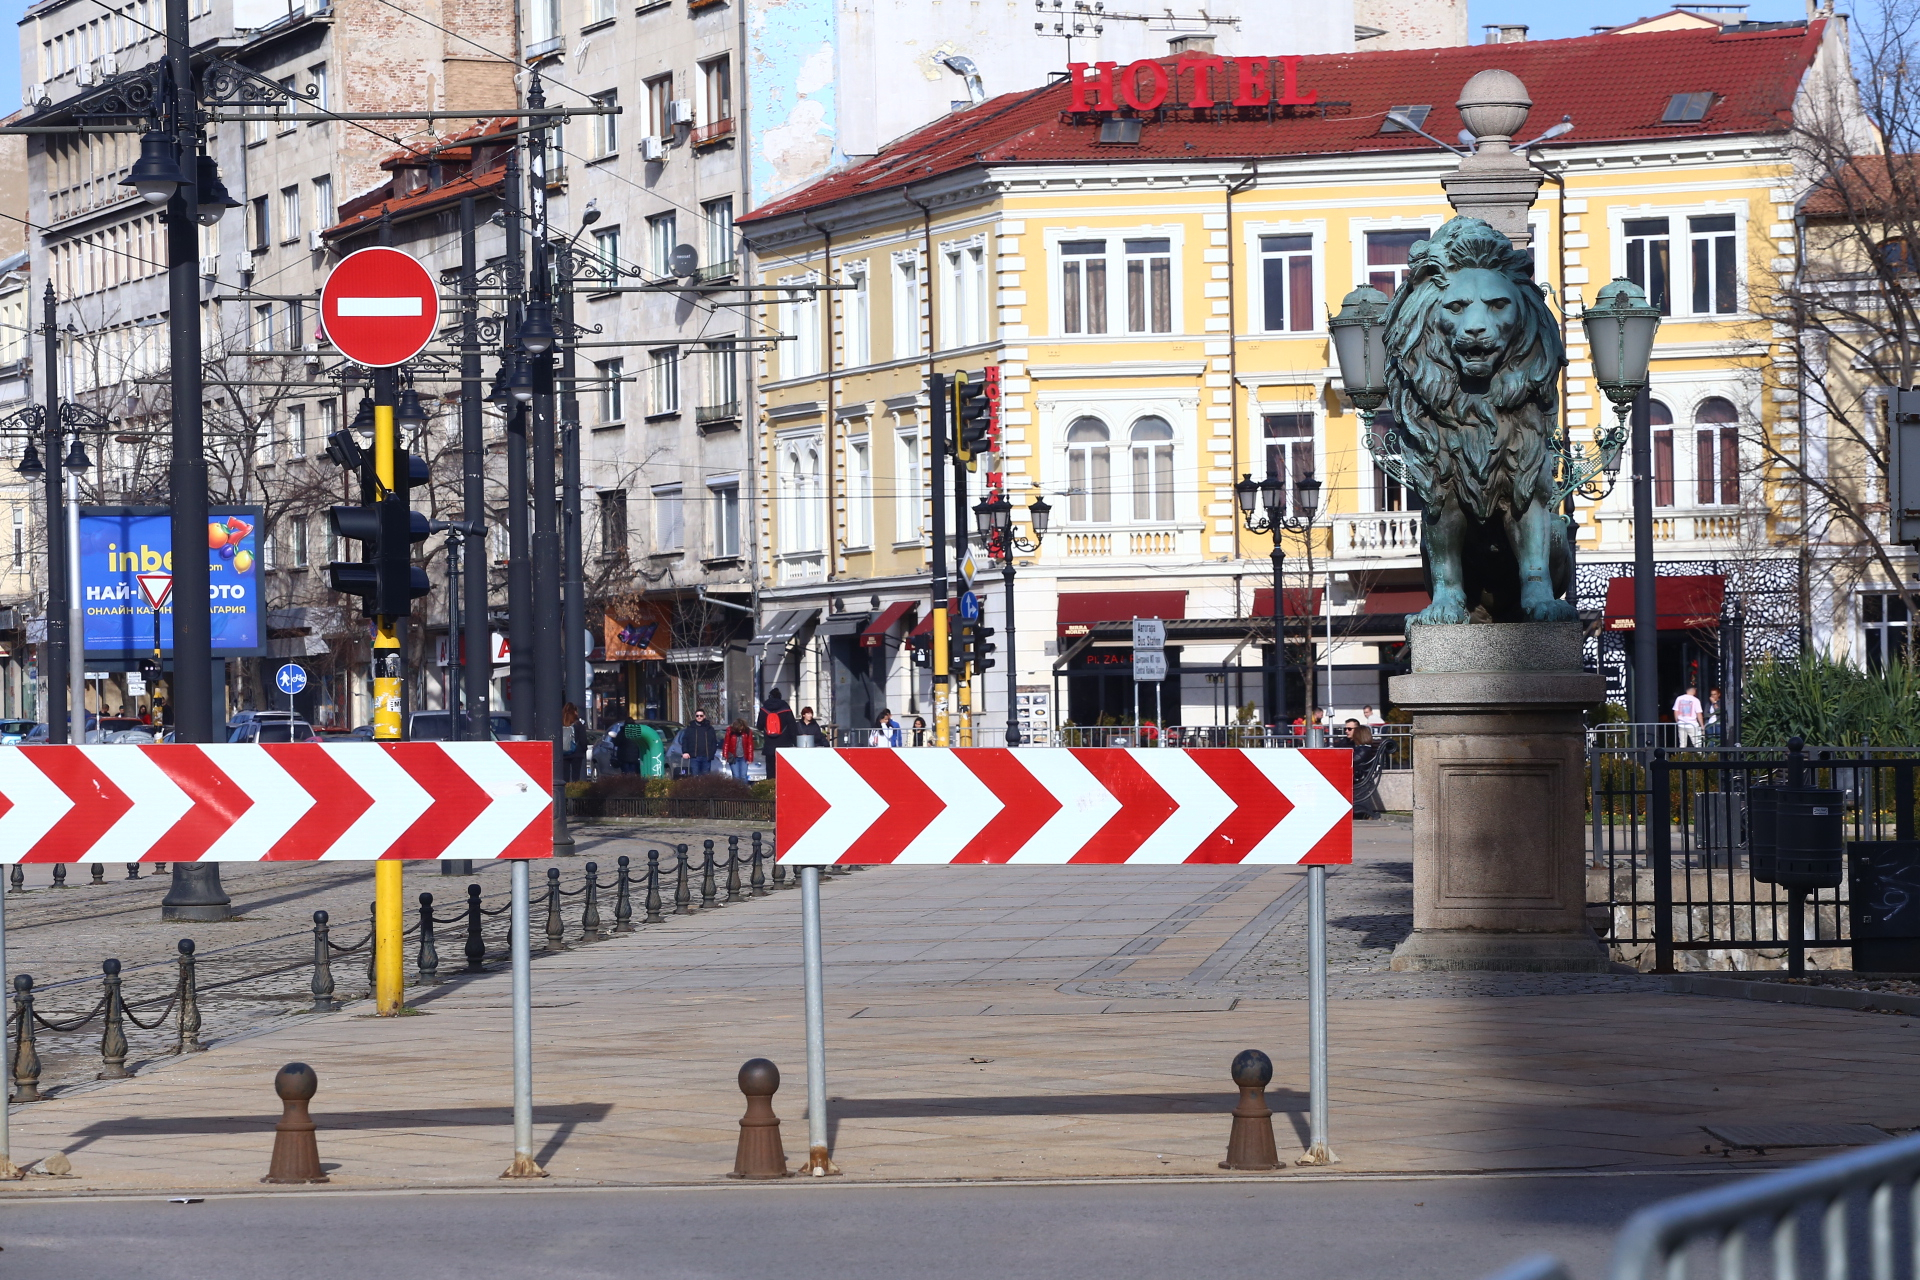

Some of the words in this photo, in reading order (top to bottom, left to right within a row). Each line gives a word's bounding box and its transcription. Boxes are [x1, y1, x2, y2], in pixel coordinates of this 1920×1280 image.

[1066, 55, 1318, 112] HOTEL
[984, 366, 1001, 452] HOTEL
[87, 605, 134, 616] ОНЛАЙН
